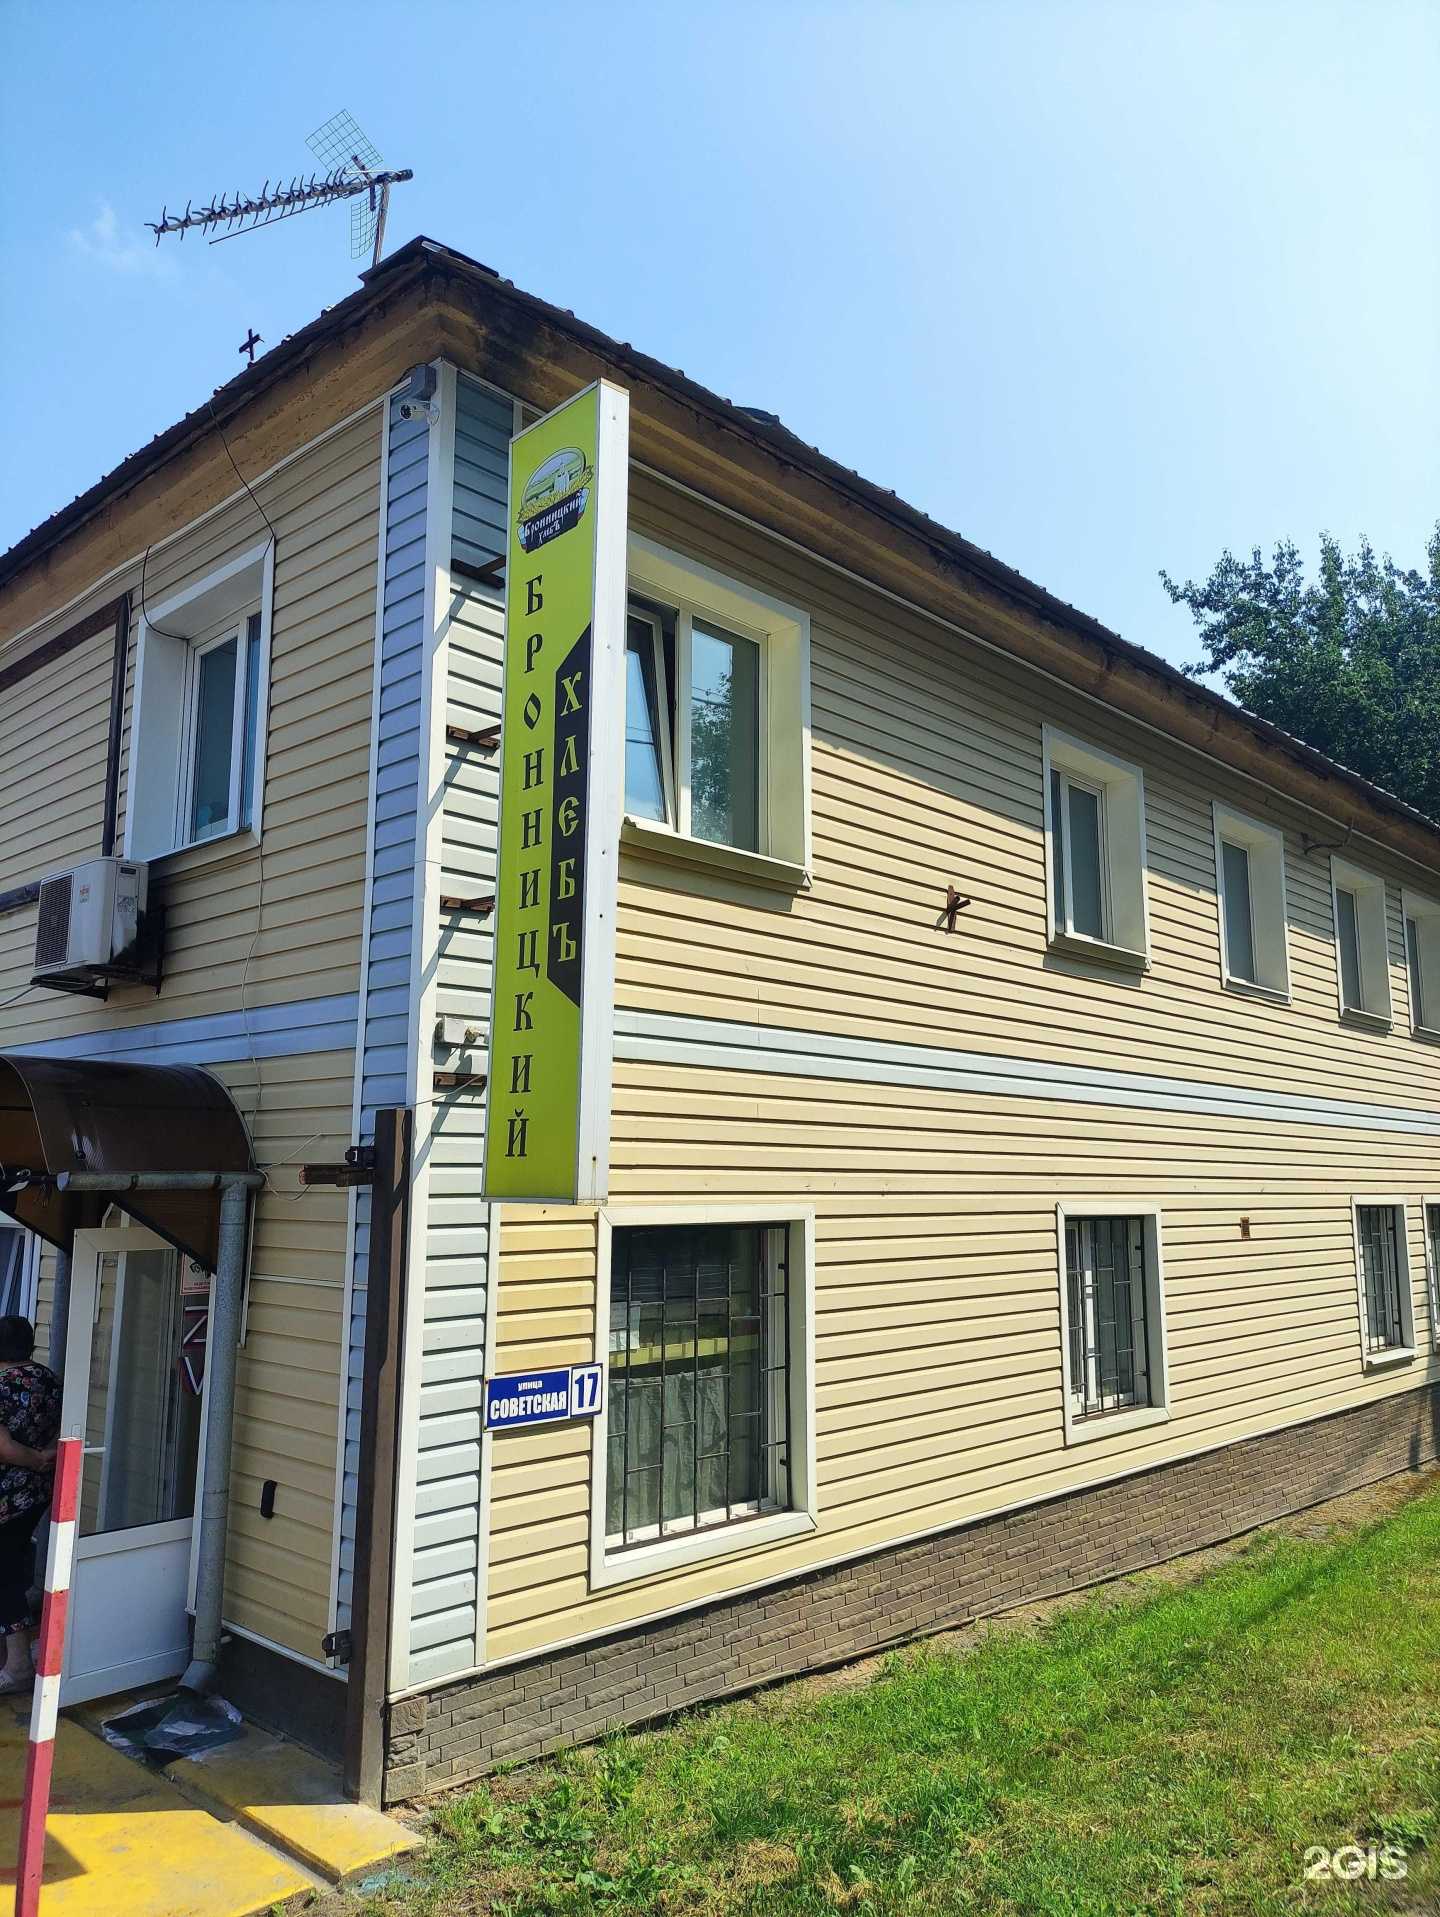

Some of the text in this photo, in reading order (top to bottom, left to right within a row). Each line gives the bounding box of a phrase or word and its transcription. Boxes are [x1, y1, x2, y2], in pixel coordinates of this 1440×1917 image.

[505, 574, 544, 1157] БРОННИЦКИЙ
[490, 1373, 599, 1420] СОВЕТСКАЯ 17
[518, 1380, 542, 1391] улица
